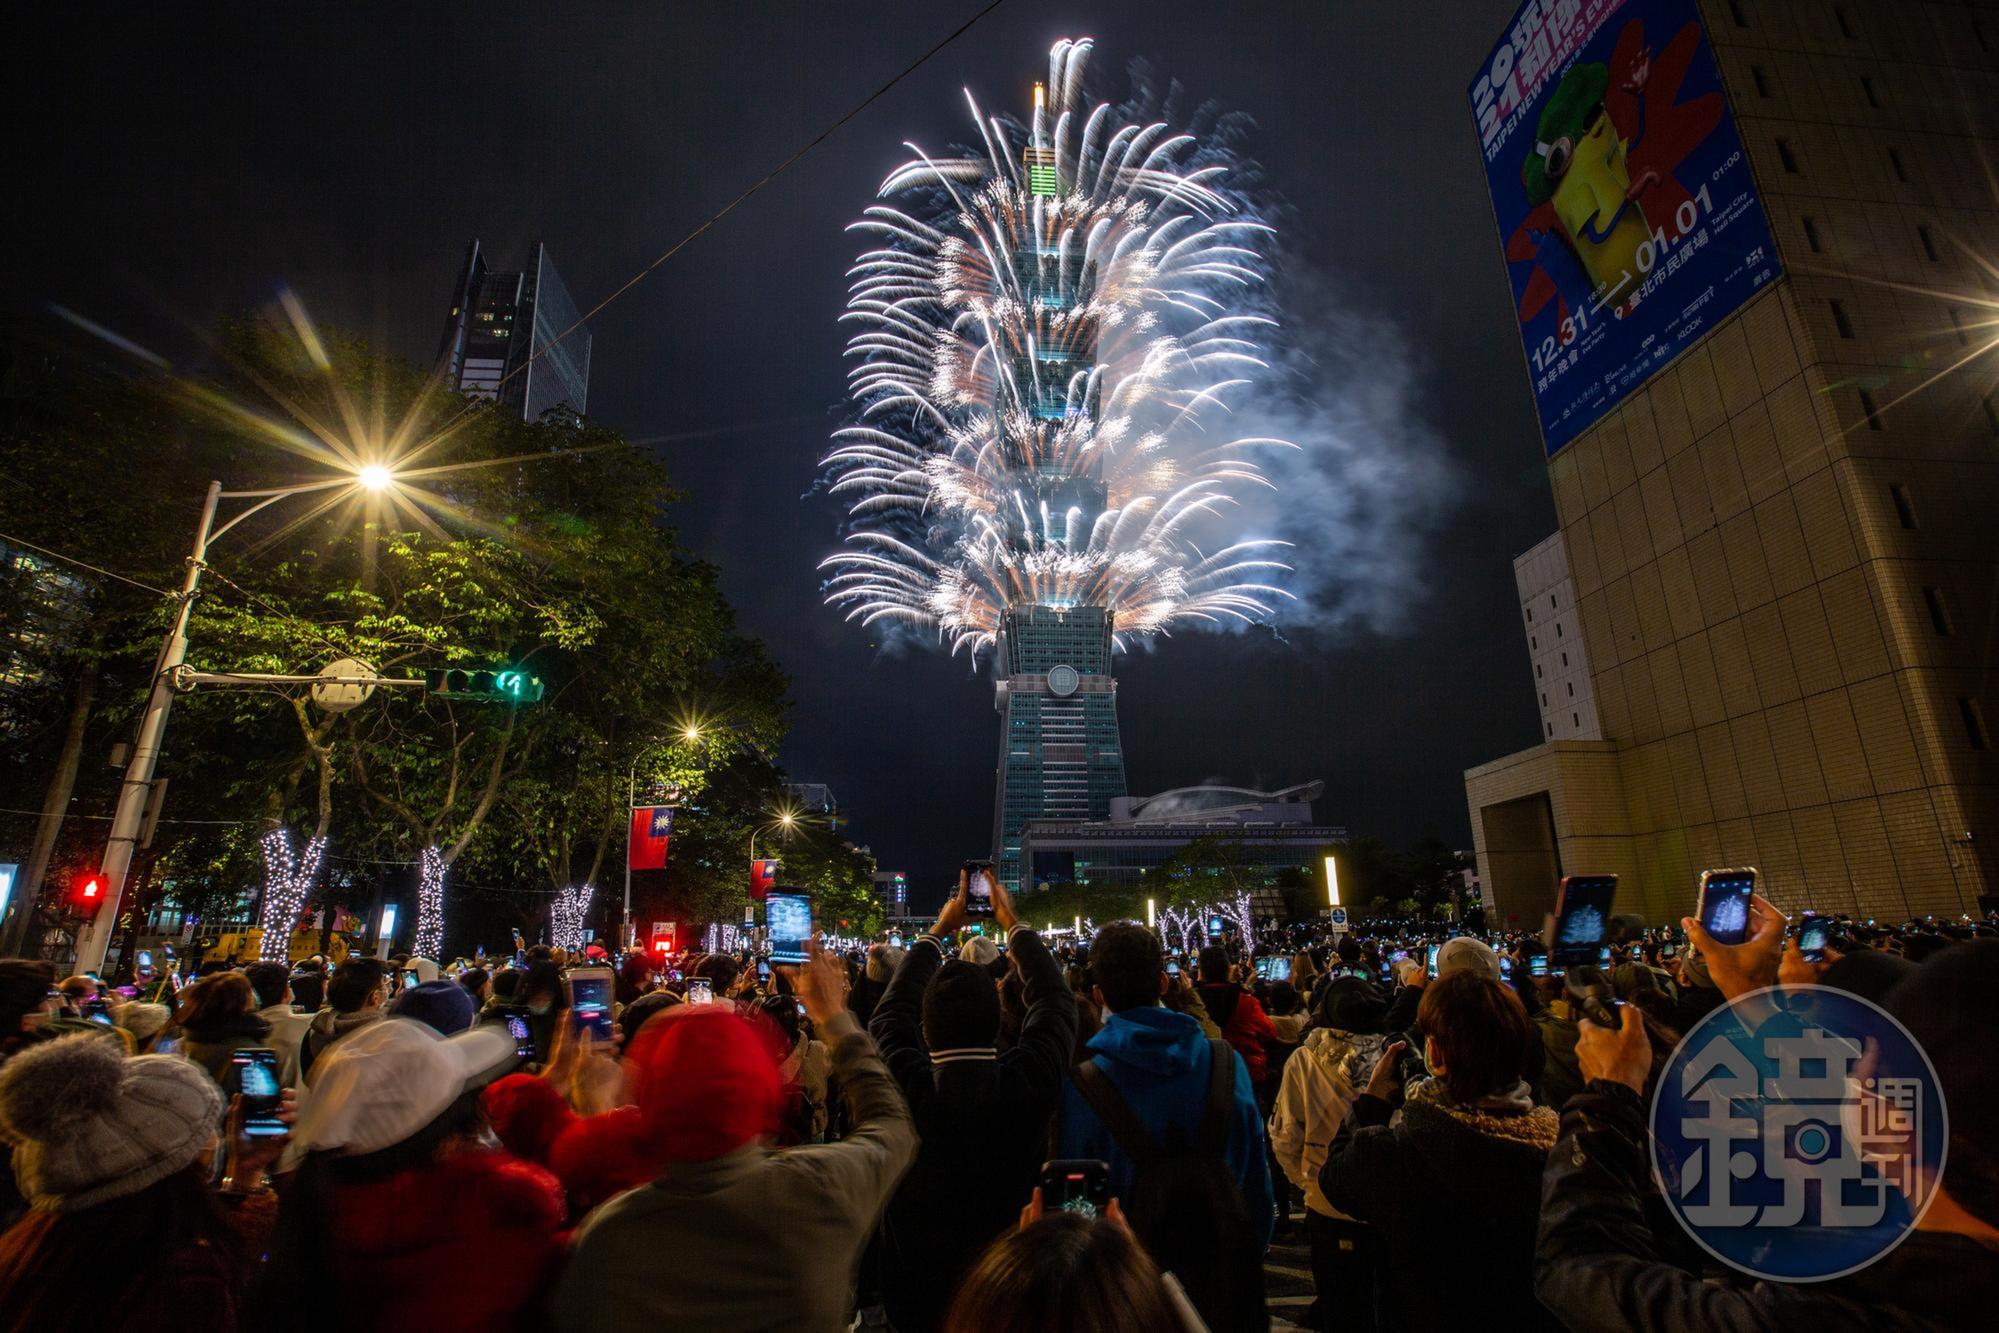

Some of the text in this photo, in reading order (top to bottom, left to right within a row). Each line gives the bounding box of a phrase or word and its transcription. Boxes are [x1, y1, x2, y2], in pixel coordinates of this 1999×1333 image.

[1486, 112, 1518, 163] TAIPEI
[1518, 77, 1542, 117] NEW
[1541, 18, 1586, 83] YEAR'S
[1712, 151, 1740, 181] 01:00
[1635, 183, 1712, 273] 01.01
[1711, 191, 1748, 226] Taipei City
[1713, 197, 1754, 235] Hall Square
[1628, 228, 1709, 310] 臺北市民廣場
[1532, 304, 1587, 372] 12.31
